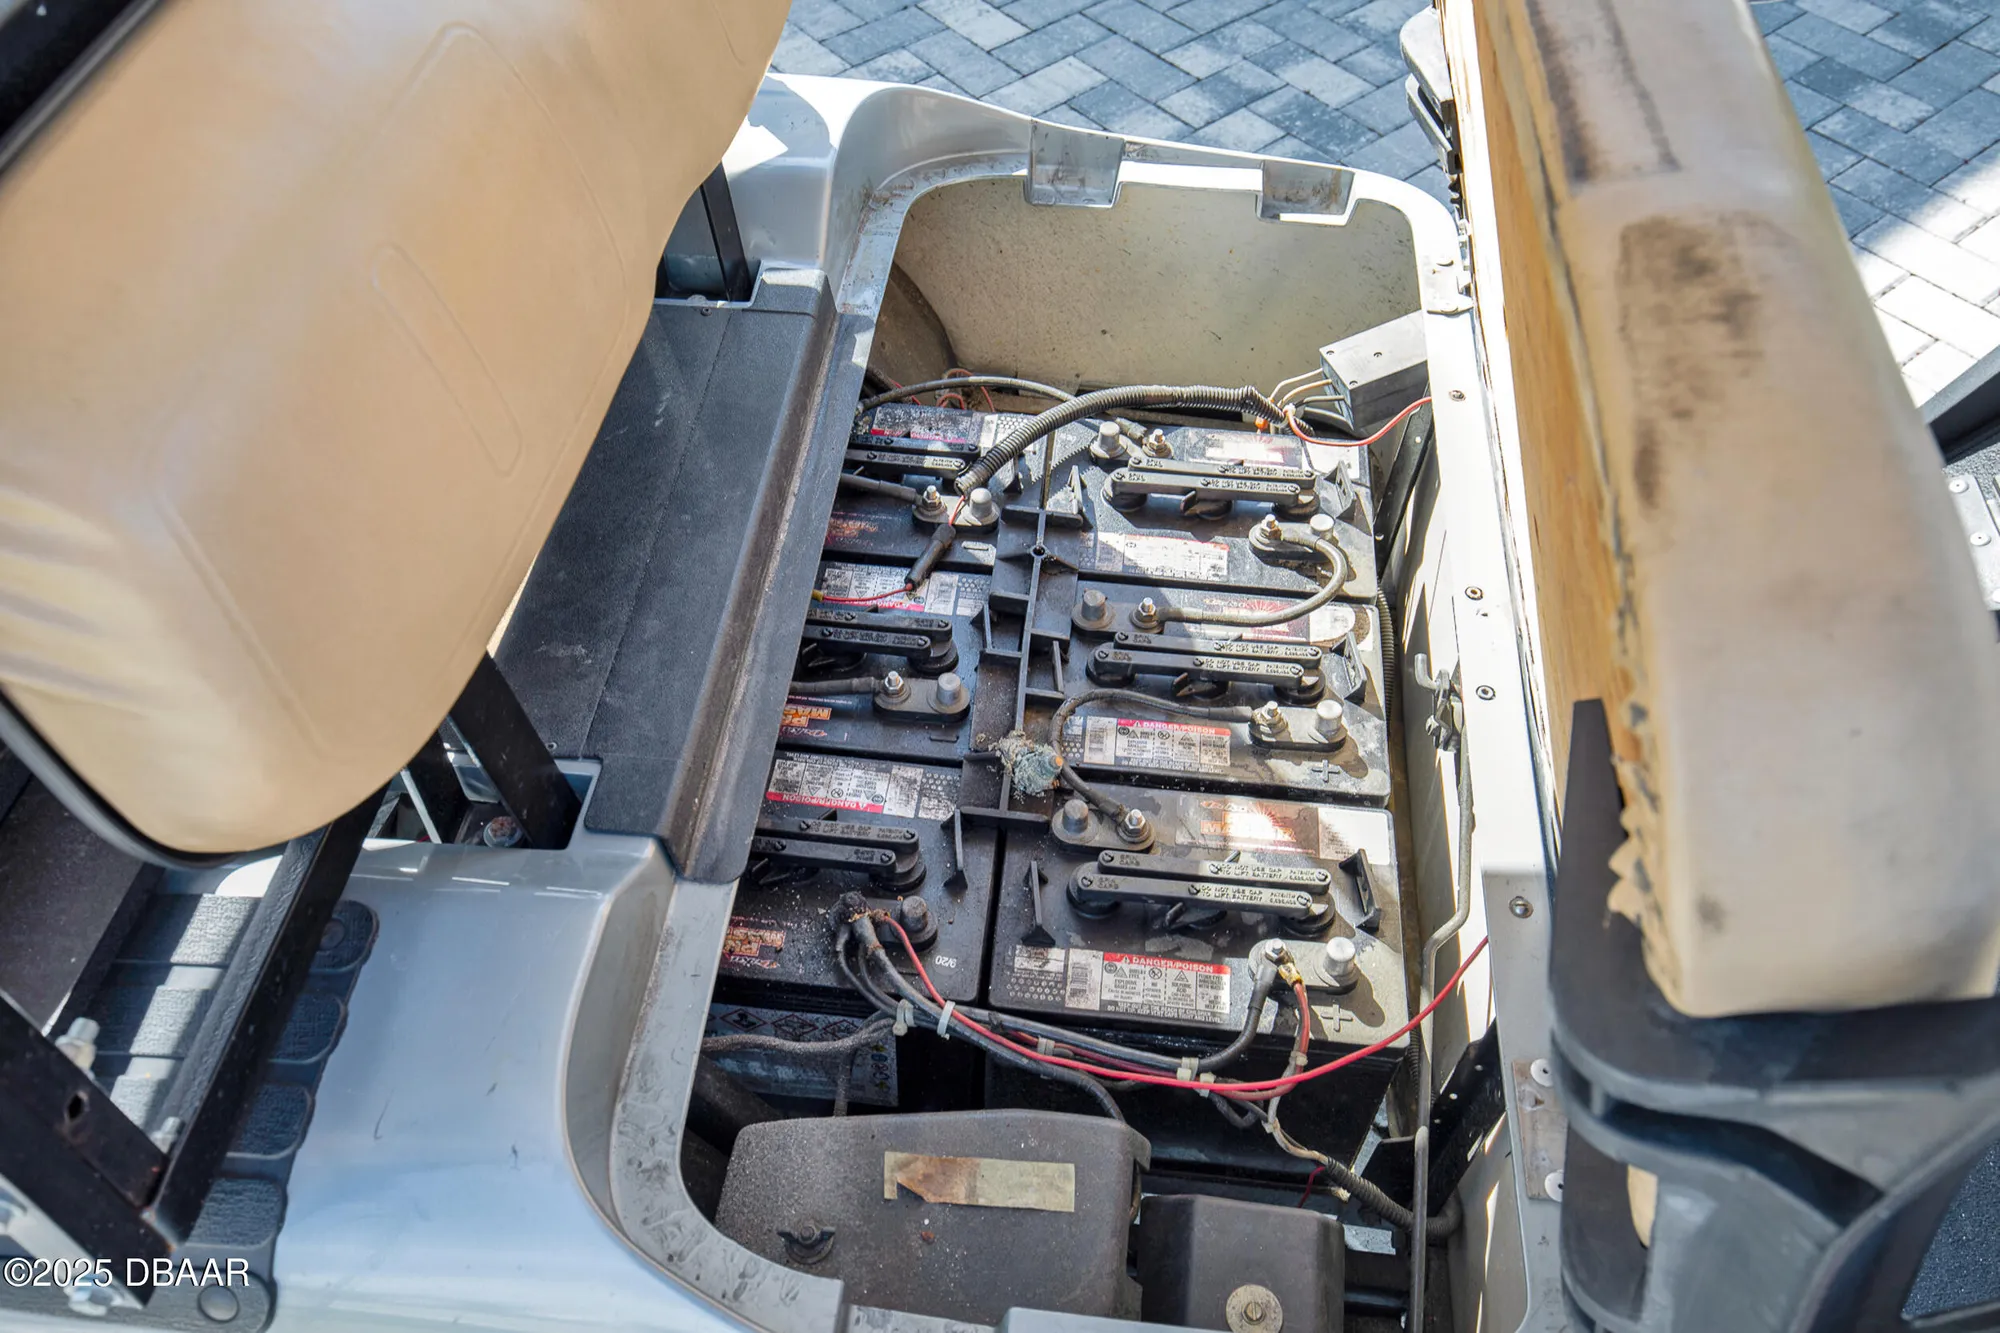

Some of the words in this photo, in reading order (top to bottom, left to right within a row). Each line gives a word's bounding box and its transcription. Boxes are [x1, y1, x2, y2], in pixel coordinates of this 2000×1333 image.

[1143, 722, 1216, 734] DANGER/POISON
[782, 793, 857, 808] DANGER/POISON
[935, 955, 957, 968] 9/20
[1132, 956, 1214, 973] DANGER/POISON
